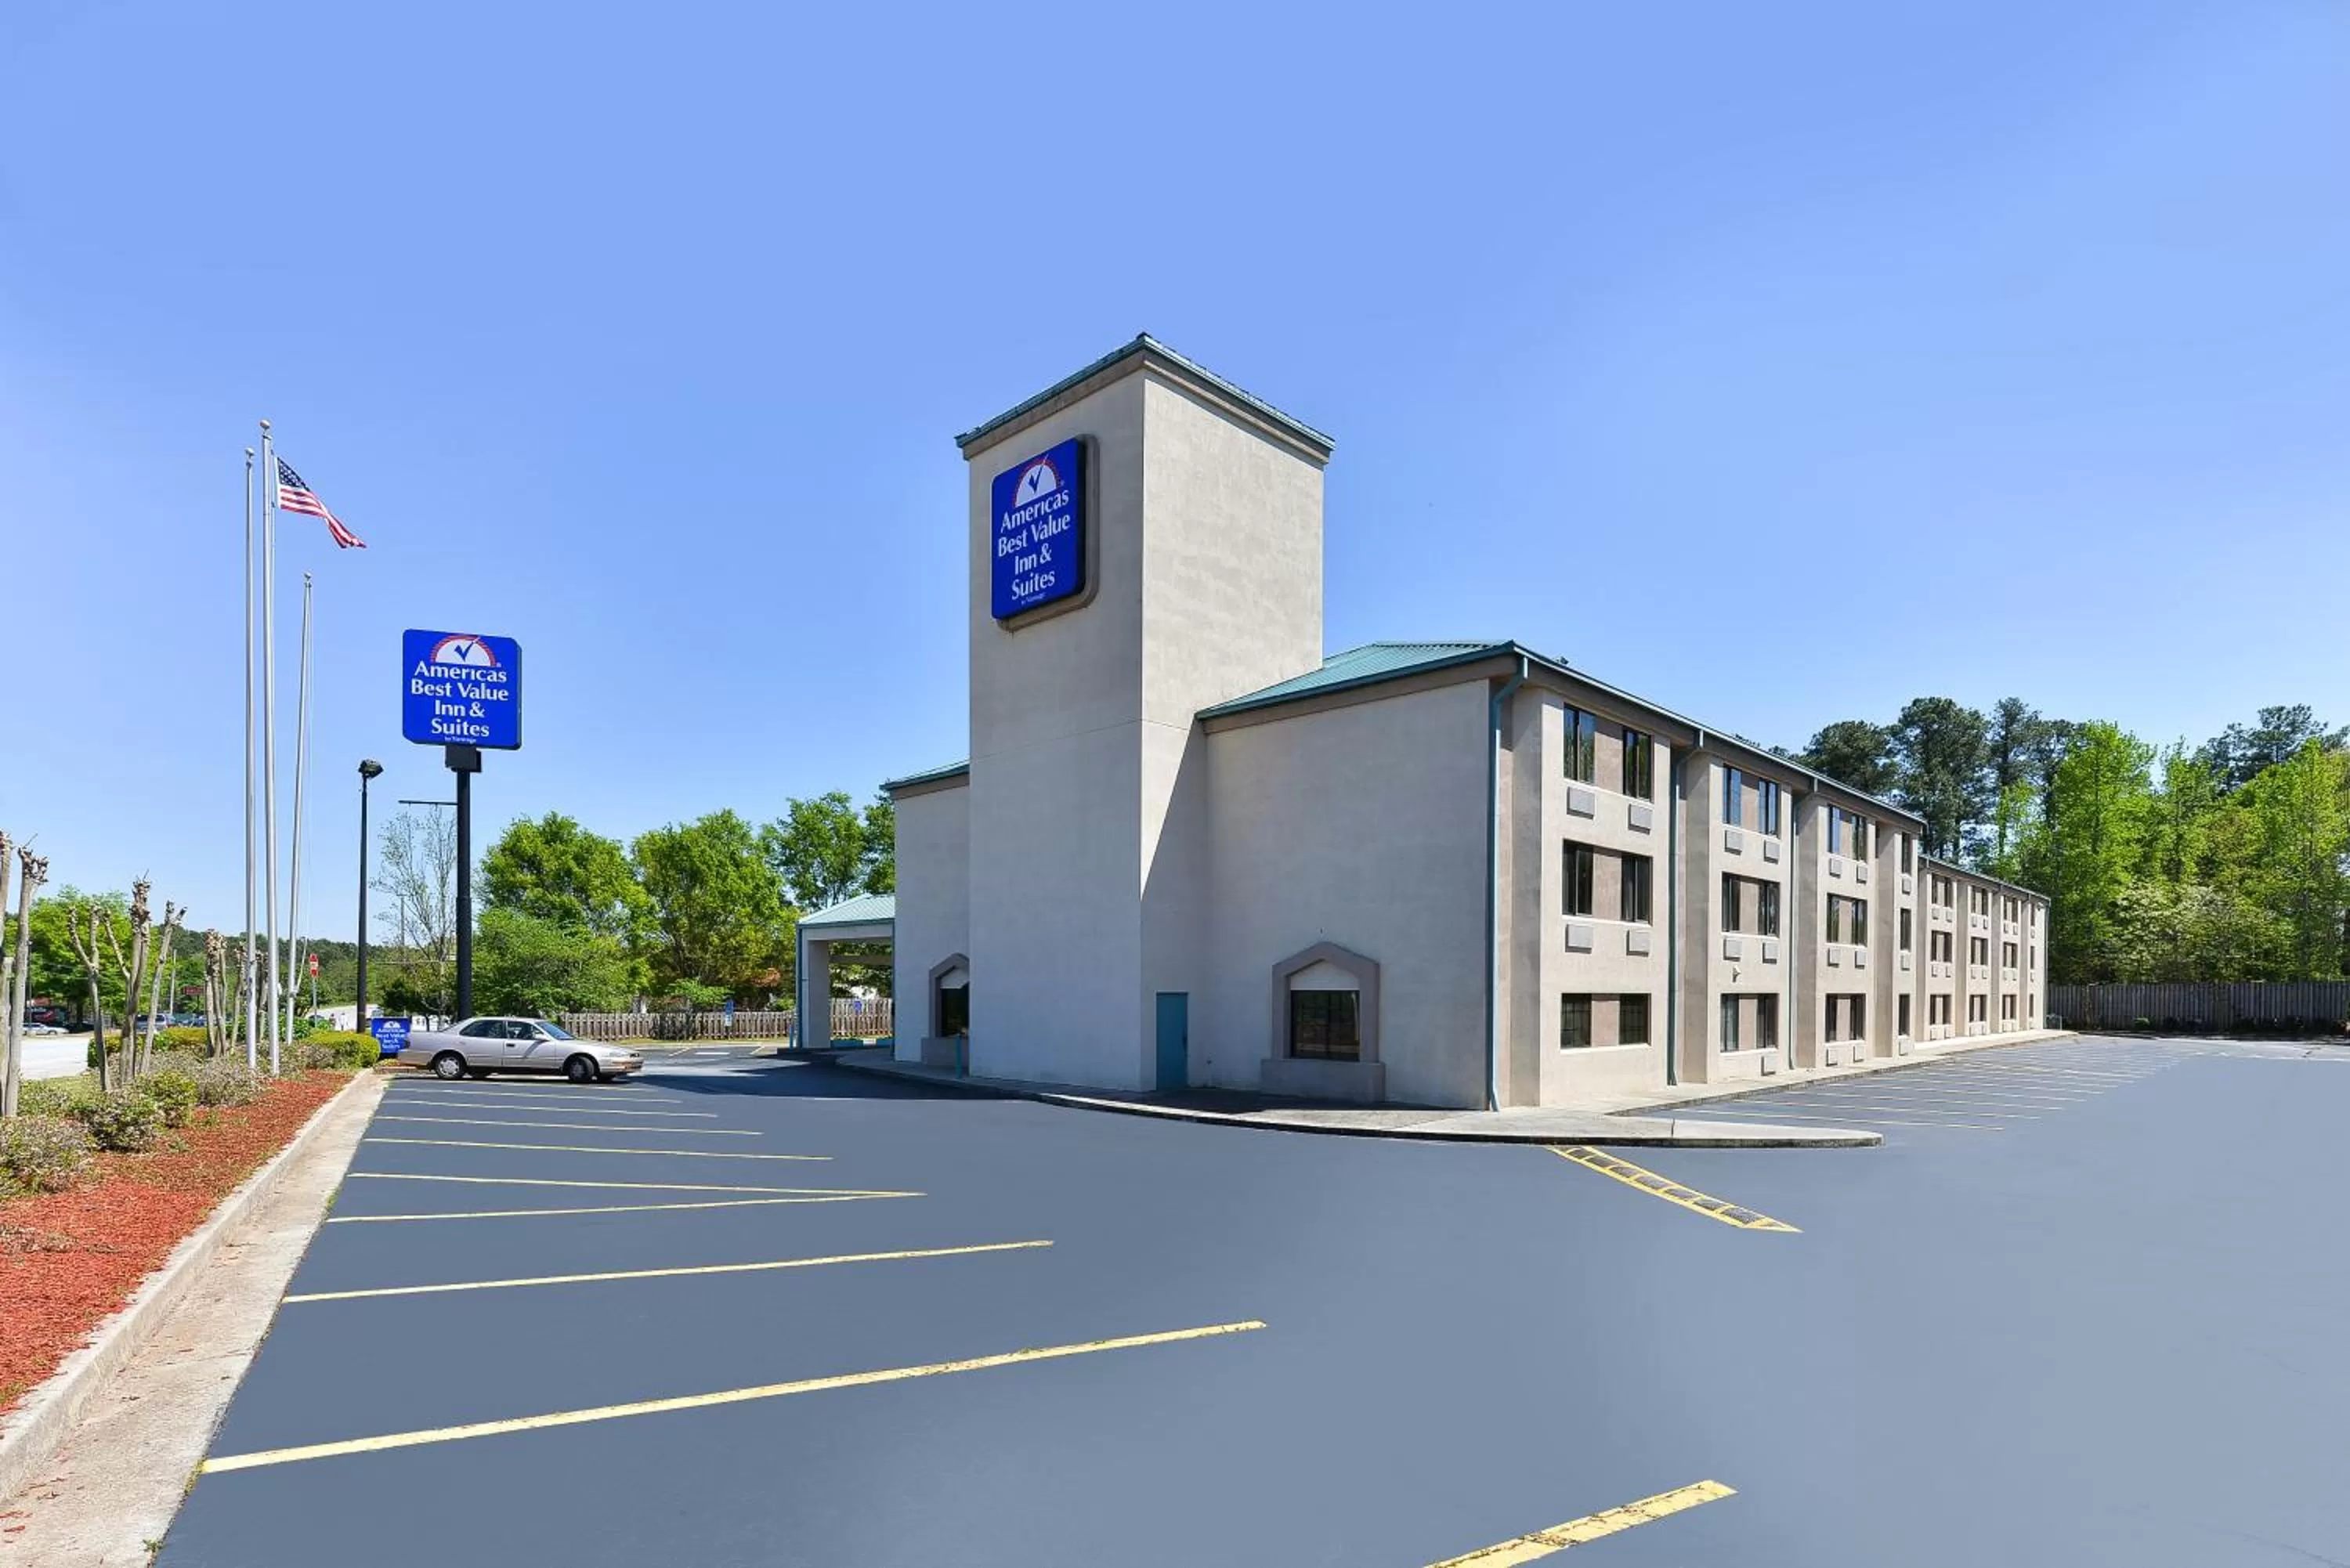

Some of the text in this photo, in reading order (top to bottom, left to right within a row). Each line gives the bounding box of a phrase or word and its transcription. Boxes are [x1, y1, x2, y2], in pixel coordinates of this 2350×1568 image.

[1000, 490, 1069, 533] Americas
[998, 514, 1071, 558] Best Value
[1014, 543, 1052, 576] Inn &
[1011, 570, 1055, 600] Suites
[414, 660, 508, 683] Americas
[411, 678, 508, 701] Best Value
[435, 699, 486, 717] Inn &
[432, 717, 490, 737] Suites
